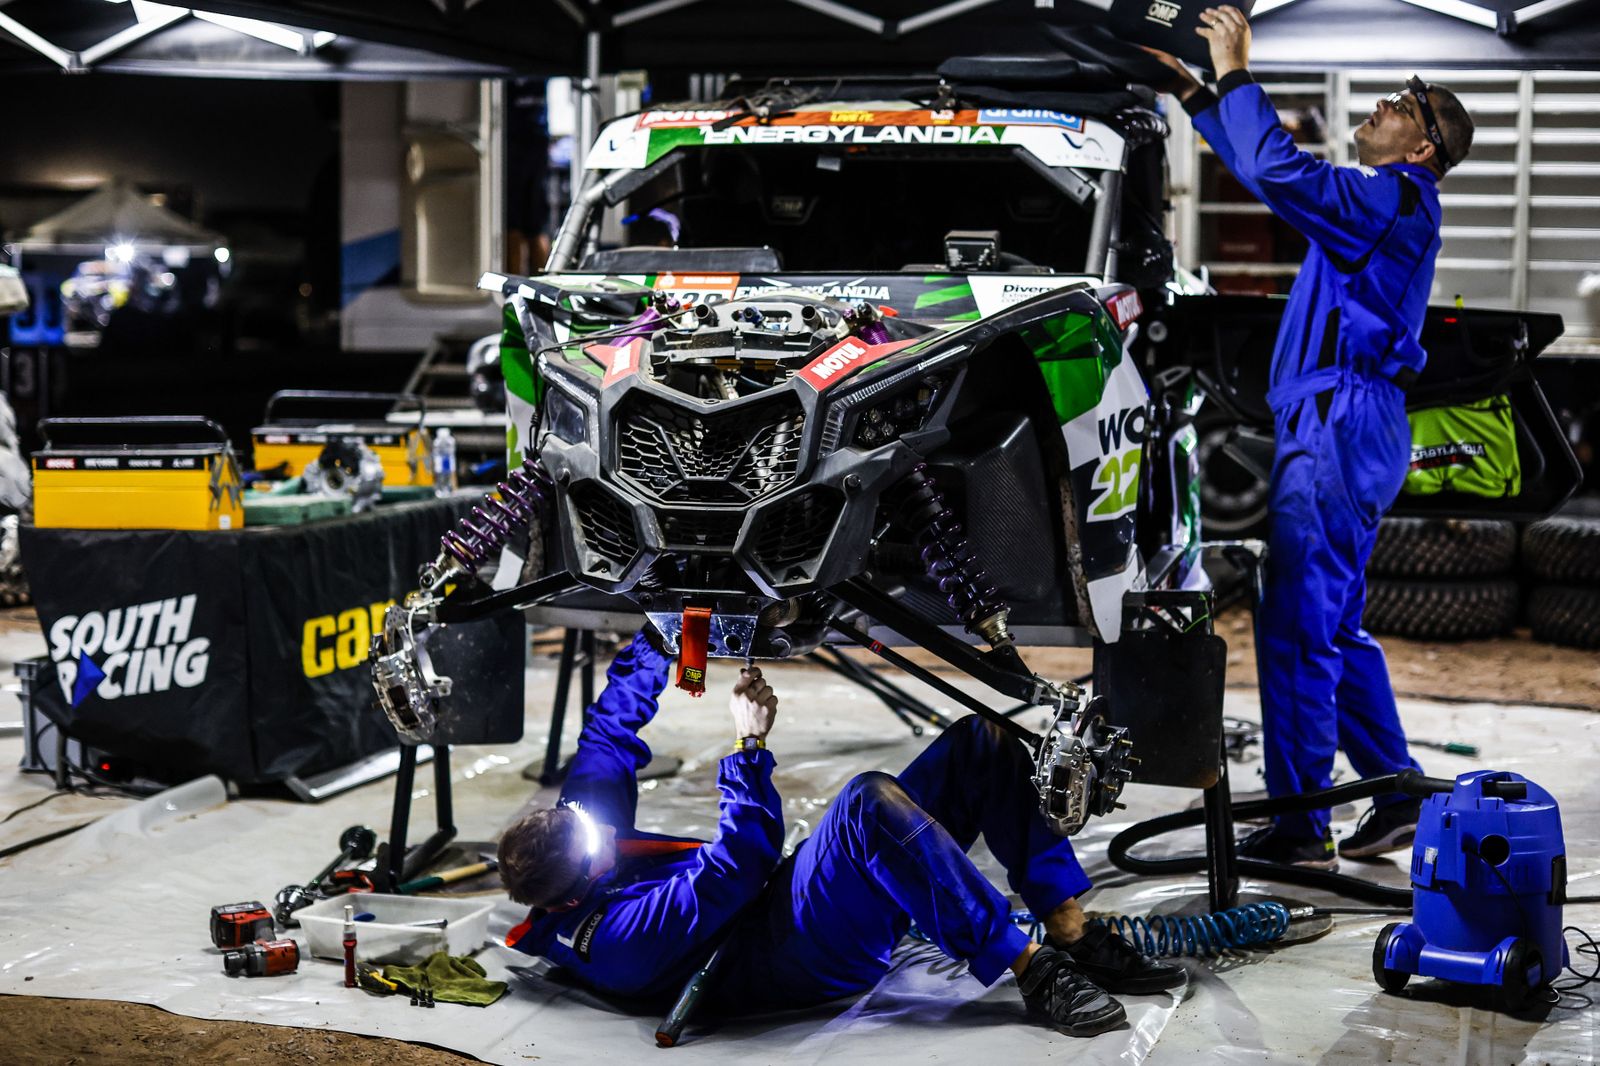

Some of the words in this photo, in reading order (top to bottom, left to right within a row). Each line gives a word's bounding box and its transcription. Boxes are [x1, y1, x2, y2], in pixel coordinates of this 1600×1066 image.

[1148, 3, 1179, 21] OMP
[701, 125, 1001, 144] ENERGYLANDIA
[811, 343, 865, 380] MOTUL
[50, 594, 198, 662] SOUTH
